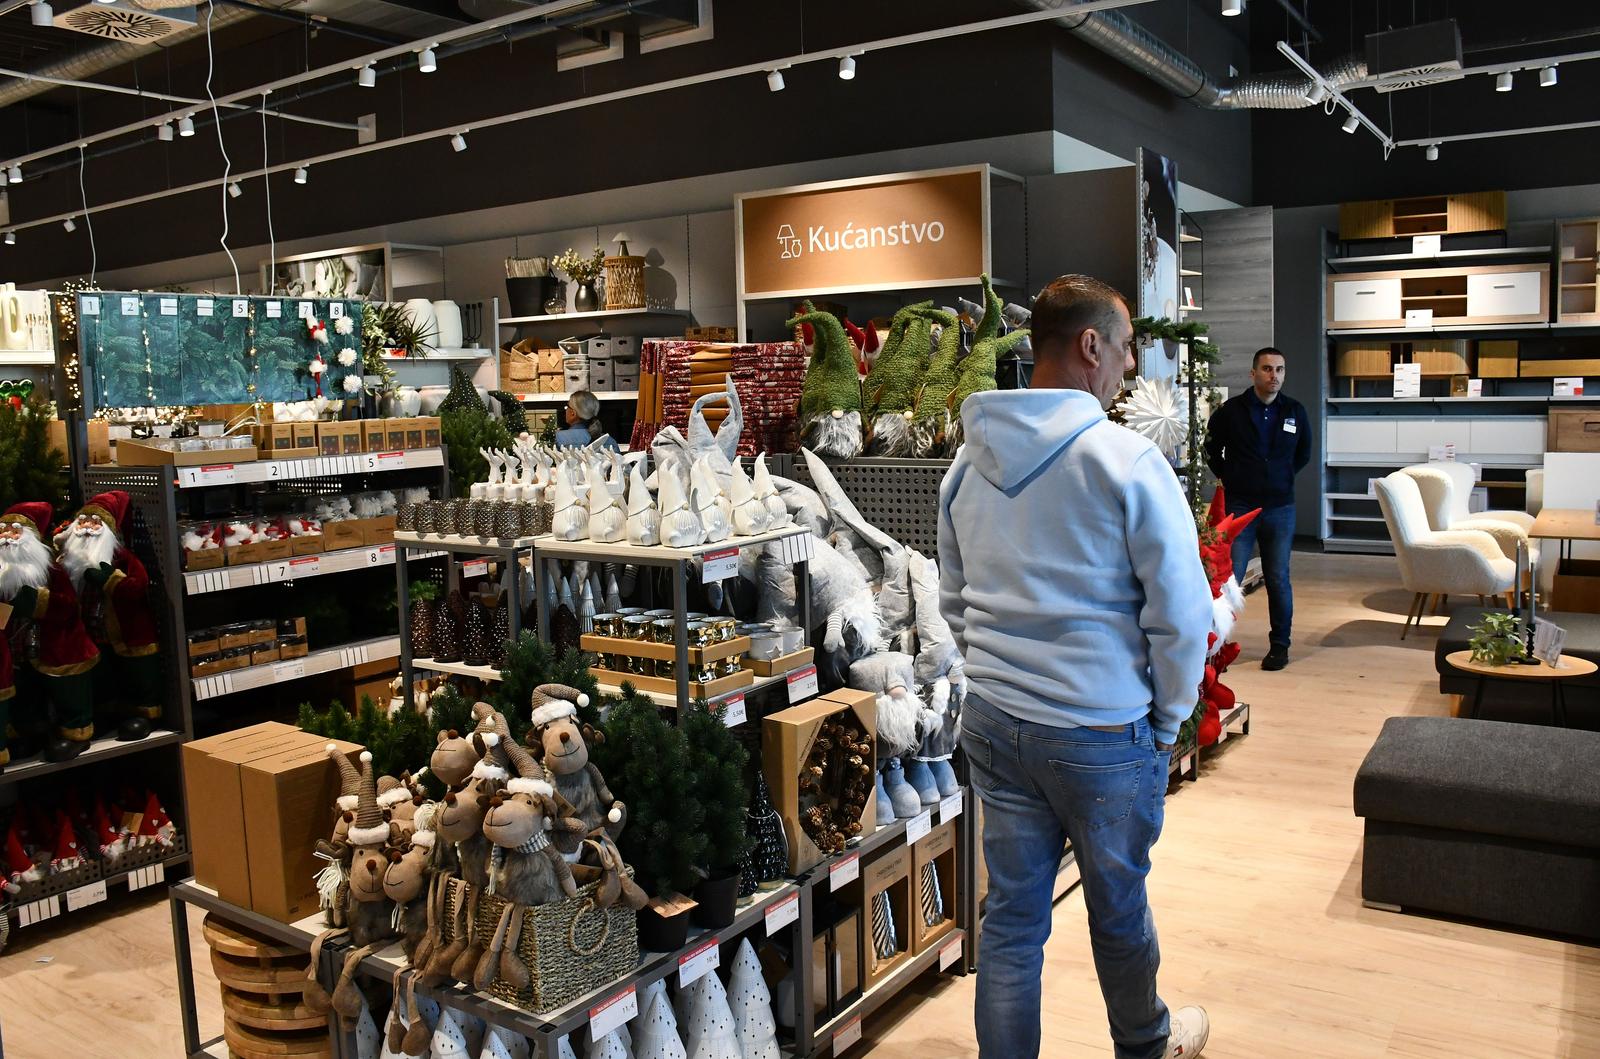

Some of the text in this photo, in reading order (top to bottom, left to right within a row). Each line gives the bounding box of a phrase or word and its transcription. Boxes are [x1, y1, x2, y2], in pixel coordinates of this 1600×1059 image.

[808, 220, 945, 253] Kućanstvo
[127, 302, 134, 312] 2
[238, 304, 244, 314] 5
[303, 305, 310, 315] 7
[333, 306, 339, 315] 8
[1140, 336, 1147, 346] 2
[368, 458, 374, 468] 5
[271, 465, 278, 476] 2
[190, 472, 196, 483] 1
[370, 553, 376, 563] 8
[279, 566, 285, 577] 7
